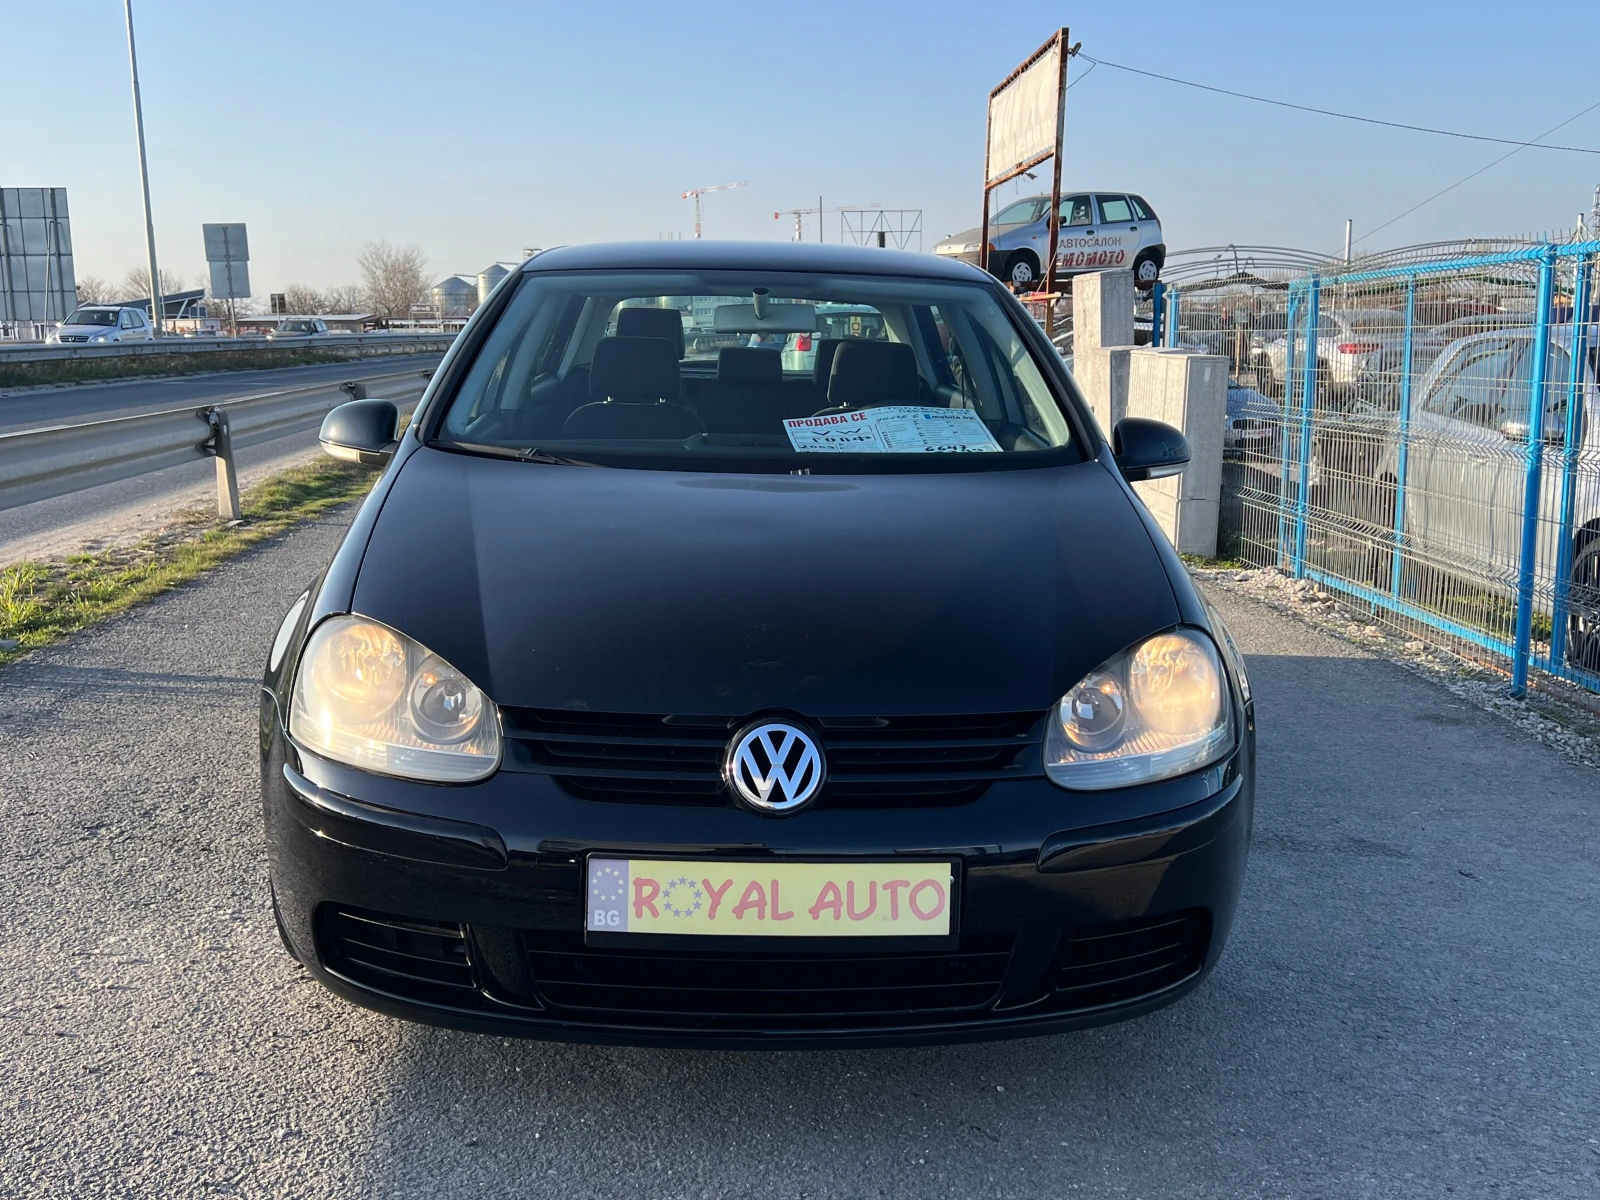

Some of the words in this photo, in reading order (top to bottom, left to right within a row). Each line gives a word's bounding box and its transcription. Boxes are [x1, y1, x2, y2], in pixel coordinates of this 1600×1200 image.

[1058, 236, 1121, 249] АВТОСАЛОН
[787, 415, 848, 428] ПРОДАВА
[850, 412, 868, 421] СЕ
[732, 723, 821, 809] VW
[808, 878, 946, 921] AUTO
[593, 909, 620, 927] BG
